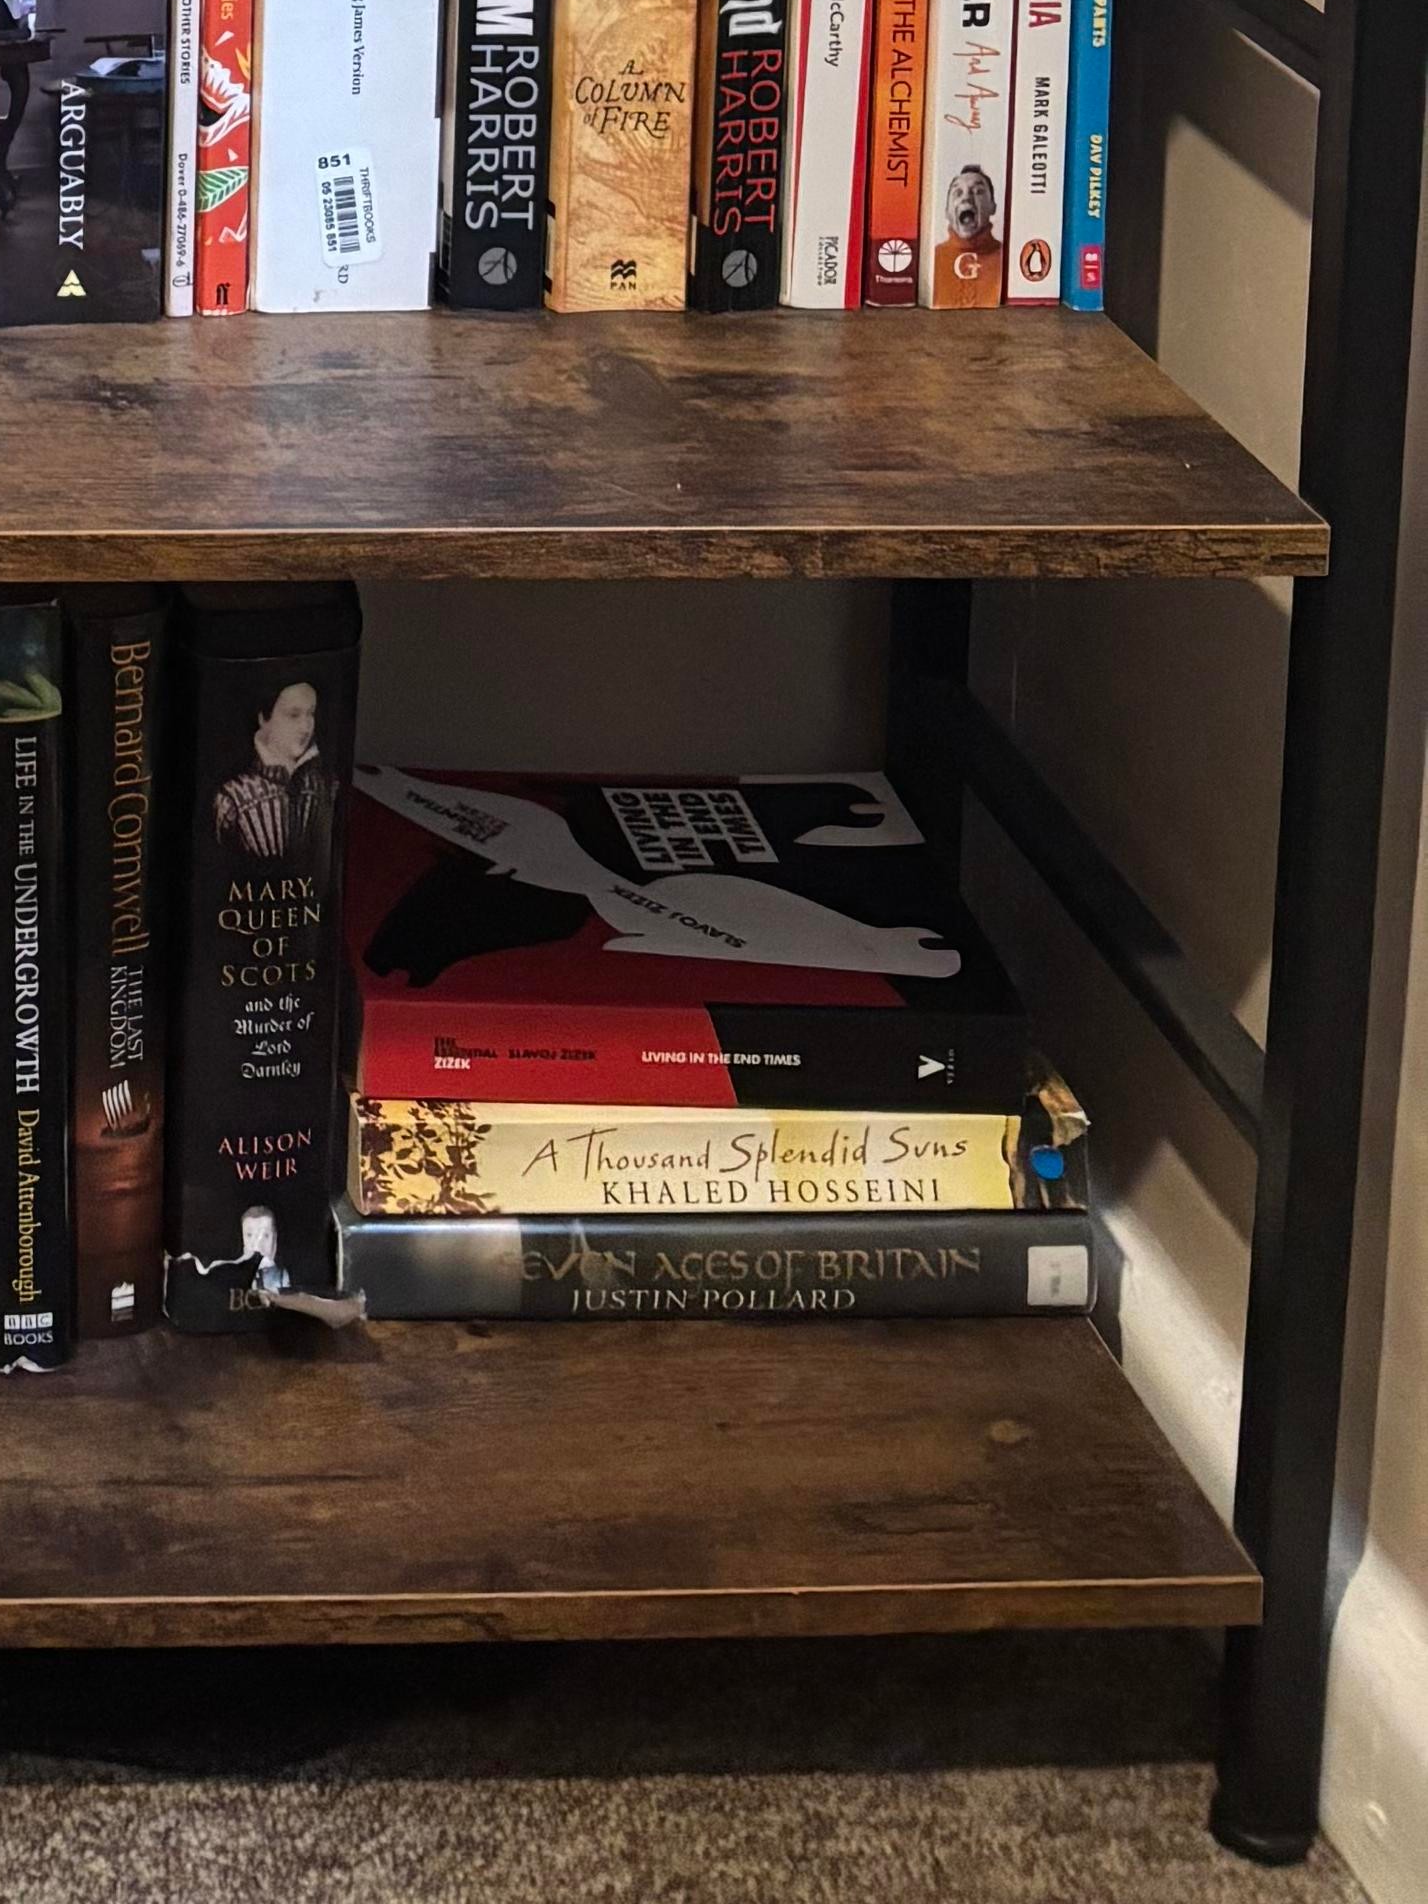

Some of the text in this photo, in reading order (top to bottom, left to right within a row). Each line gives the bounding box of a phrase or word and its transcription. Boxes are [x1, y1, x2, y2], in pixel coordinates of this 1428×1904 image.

[58, 80, 86, 250] ARGUABLY
[319, 154, 351, 169] 851
[12, 863, 40, 1094] UNDERGROWTH
[219, 1131, 311, 1155] ALISON
[235, 1158, 297, 1181] WEIR
[602, 1178, 939, 1204] KHALED HOSSEINI
[571, 1288, 855, 1312] JUSTIN POLLARD
